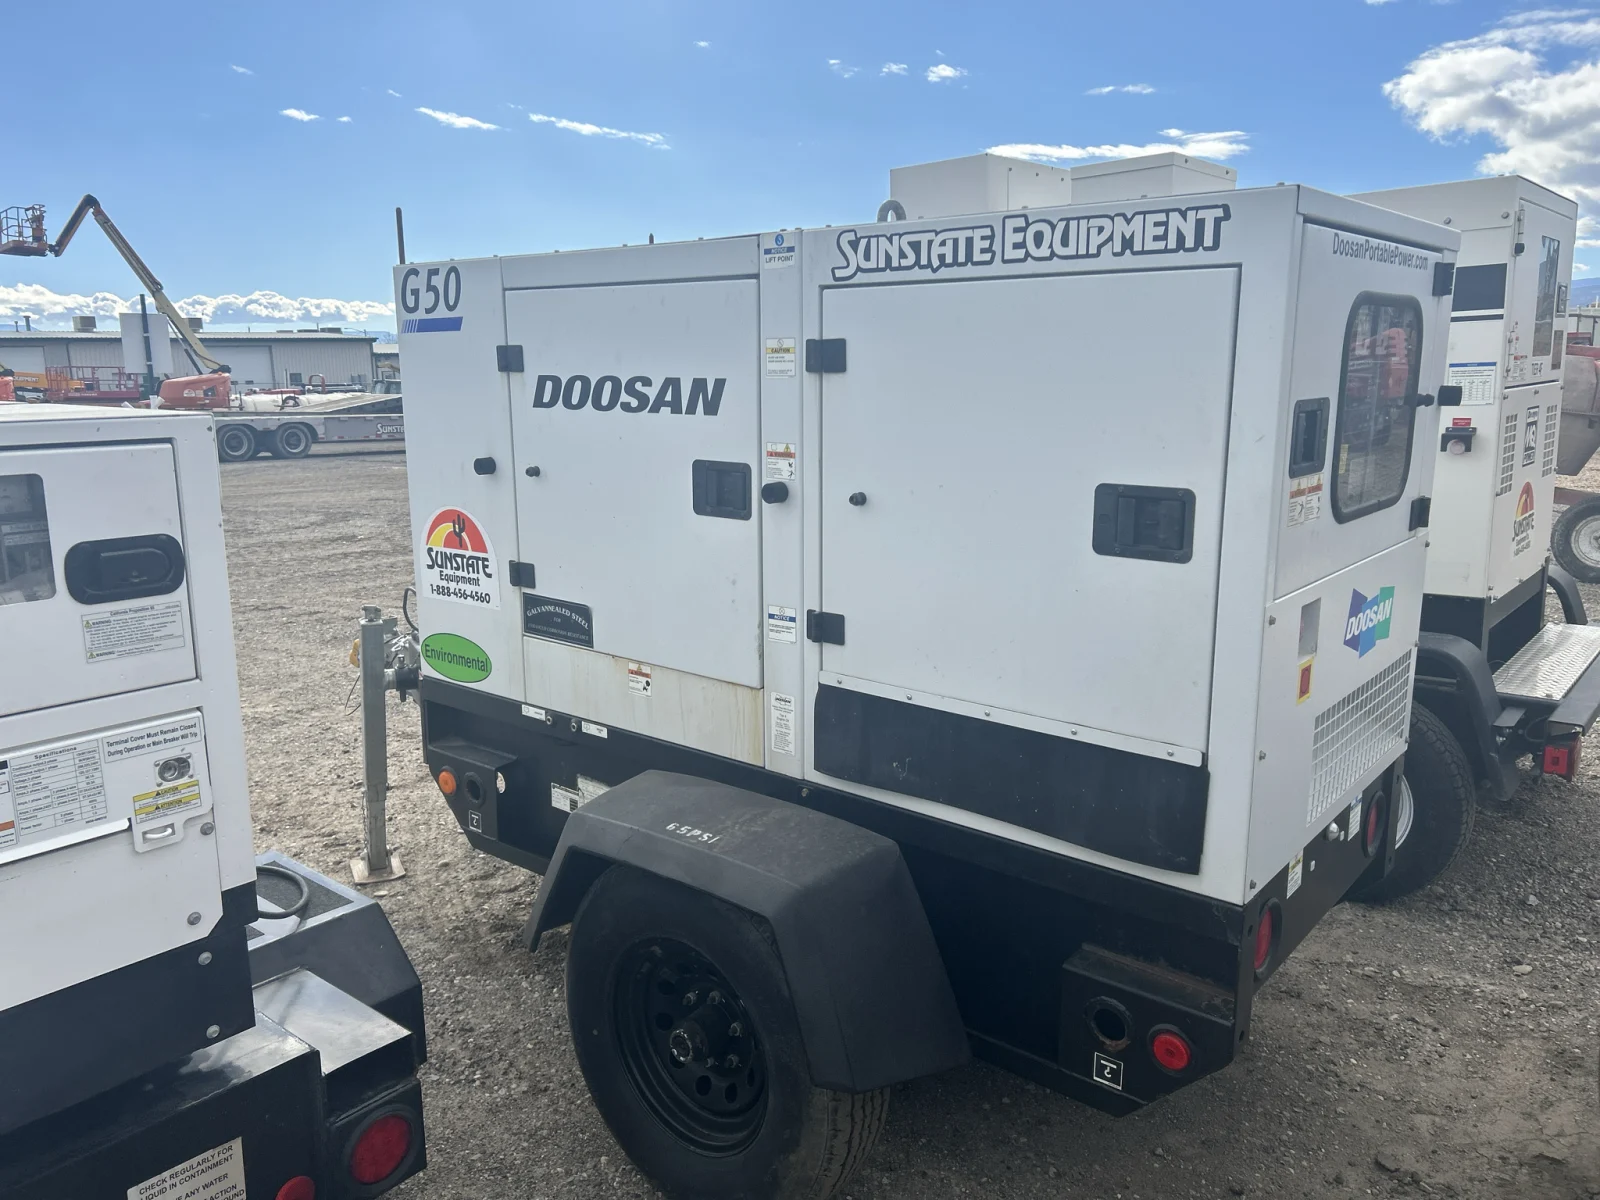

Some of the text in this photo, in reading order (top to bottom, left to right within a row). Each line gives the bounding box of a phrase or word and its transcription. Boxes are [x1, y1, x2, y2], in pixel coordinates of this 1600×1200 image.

[831, 204, 1230, 282] SUNSTATE EQUIPMENT
[1333, 232, 1428, 270] DoosanPortablePower.com
[401, 266, 462, 314] G50
[533, 374, 726, 416] DOOSAN
[426, 547, 492, 578] SUNSTATE
[440, 570, 480, 586] Equipment
[430, 584, 490, 604] 1-888-456-4560
[526, 606, 588, 630] GALVANNEALED STEEL
[1346, 598, 1392, 640] DOOSAN
[424, 644, 488, 672] Environmental
[106, 738, 129, 747] Terminal
[160, 727, 178, 735] Remain
[180, 722, 196, 731] Closed
[124, 744, 145, 753] Operation
[34, 747, 77, 760] Specifications
[666, 822, 720, 843] 65PSI
[140, 1145, 233, 1195] CHECK REGULARLY FOR
[169, 1182, 177, 1190] IN
[179, 1154, 234, 1185] CONTAINMENT
[185, 1173, 228, 1200] ANY WATER
